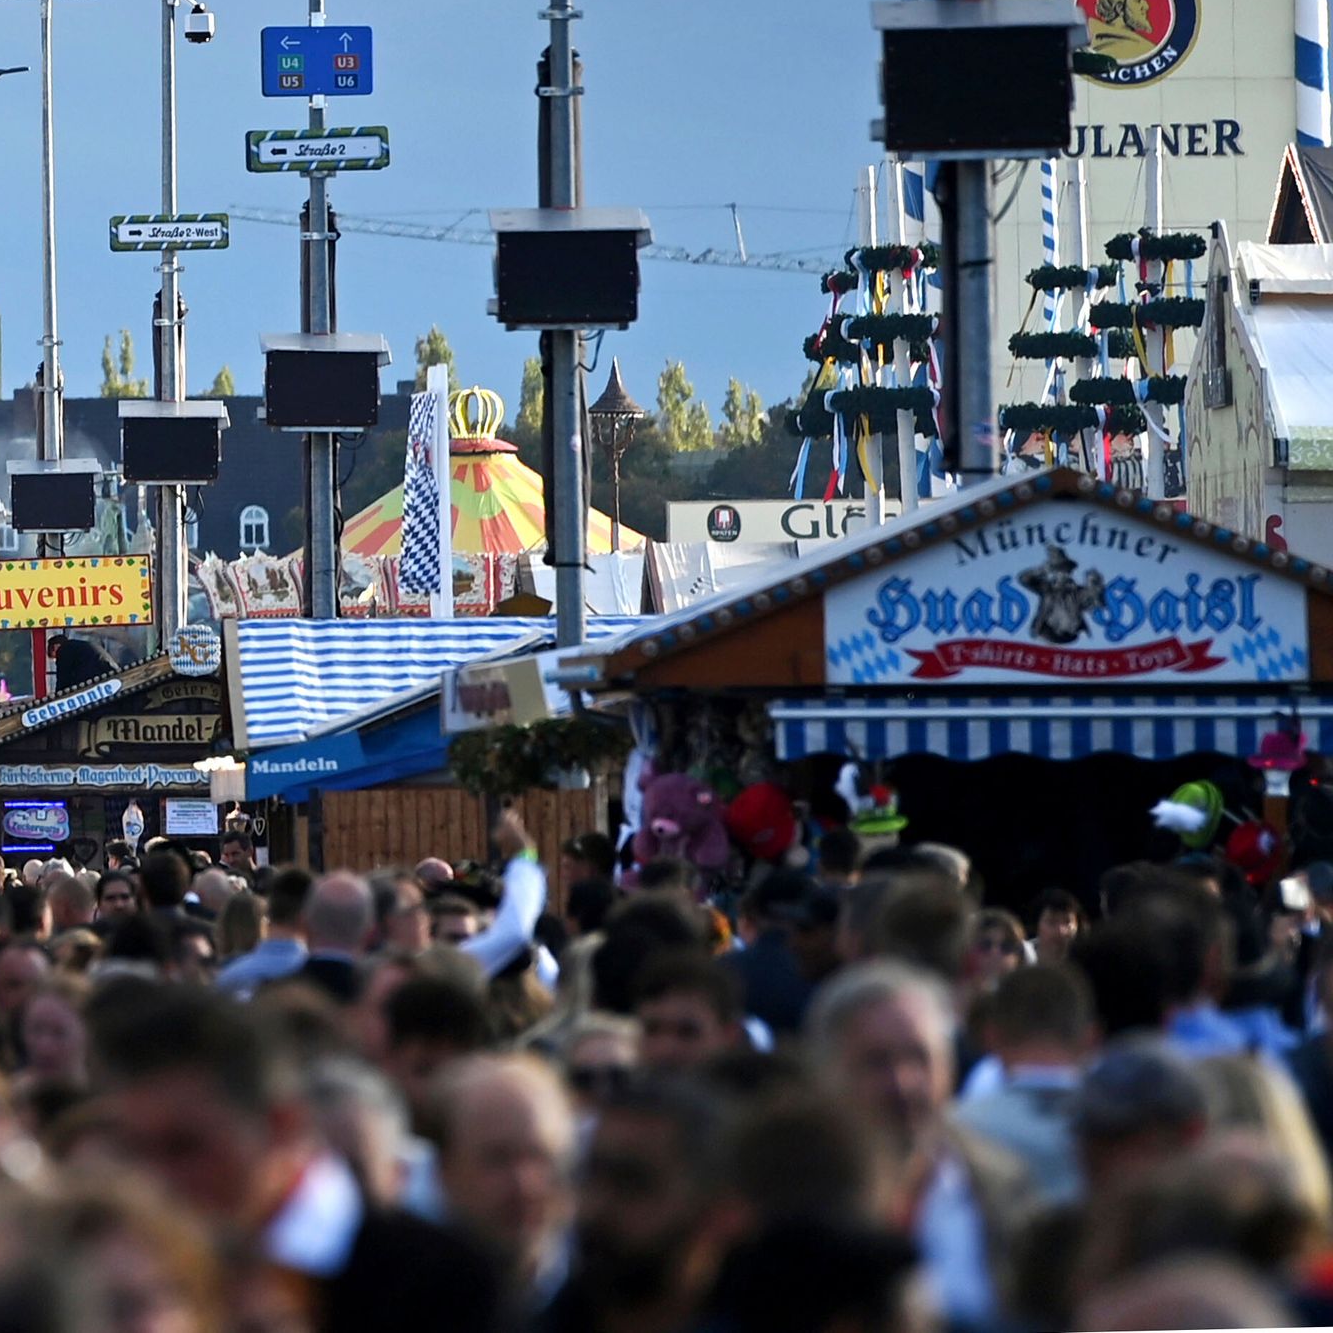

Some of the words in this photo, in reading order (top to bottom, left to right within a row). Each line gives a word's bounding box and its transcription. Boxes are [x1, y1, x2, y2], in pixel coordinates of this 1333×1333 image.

[282, 58, 300, 69] U4
[337, 57, 355, 68] U3
[282, 76, 300, 87] U5
[337, 76, 355, 87] U6
[294, 143, 337, 157] Straße
[337, 144, 347, 156] 2
[148, 226, 186, 238] Straße
[953, 511, 1179, 566] Münchner
[1051, 651, 1109, 673] Hats
[1126, 643, 1177, 670] Toys
[26, 683, 113, 724] Gebrannte
[251, 757, 339, 774] Mandeln
